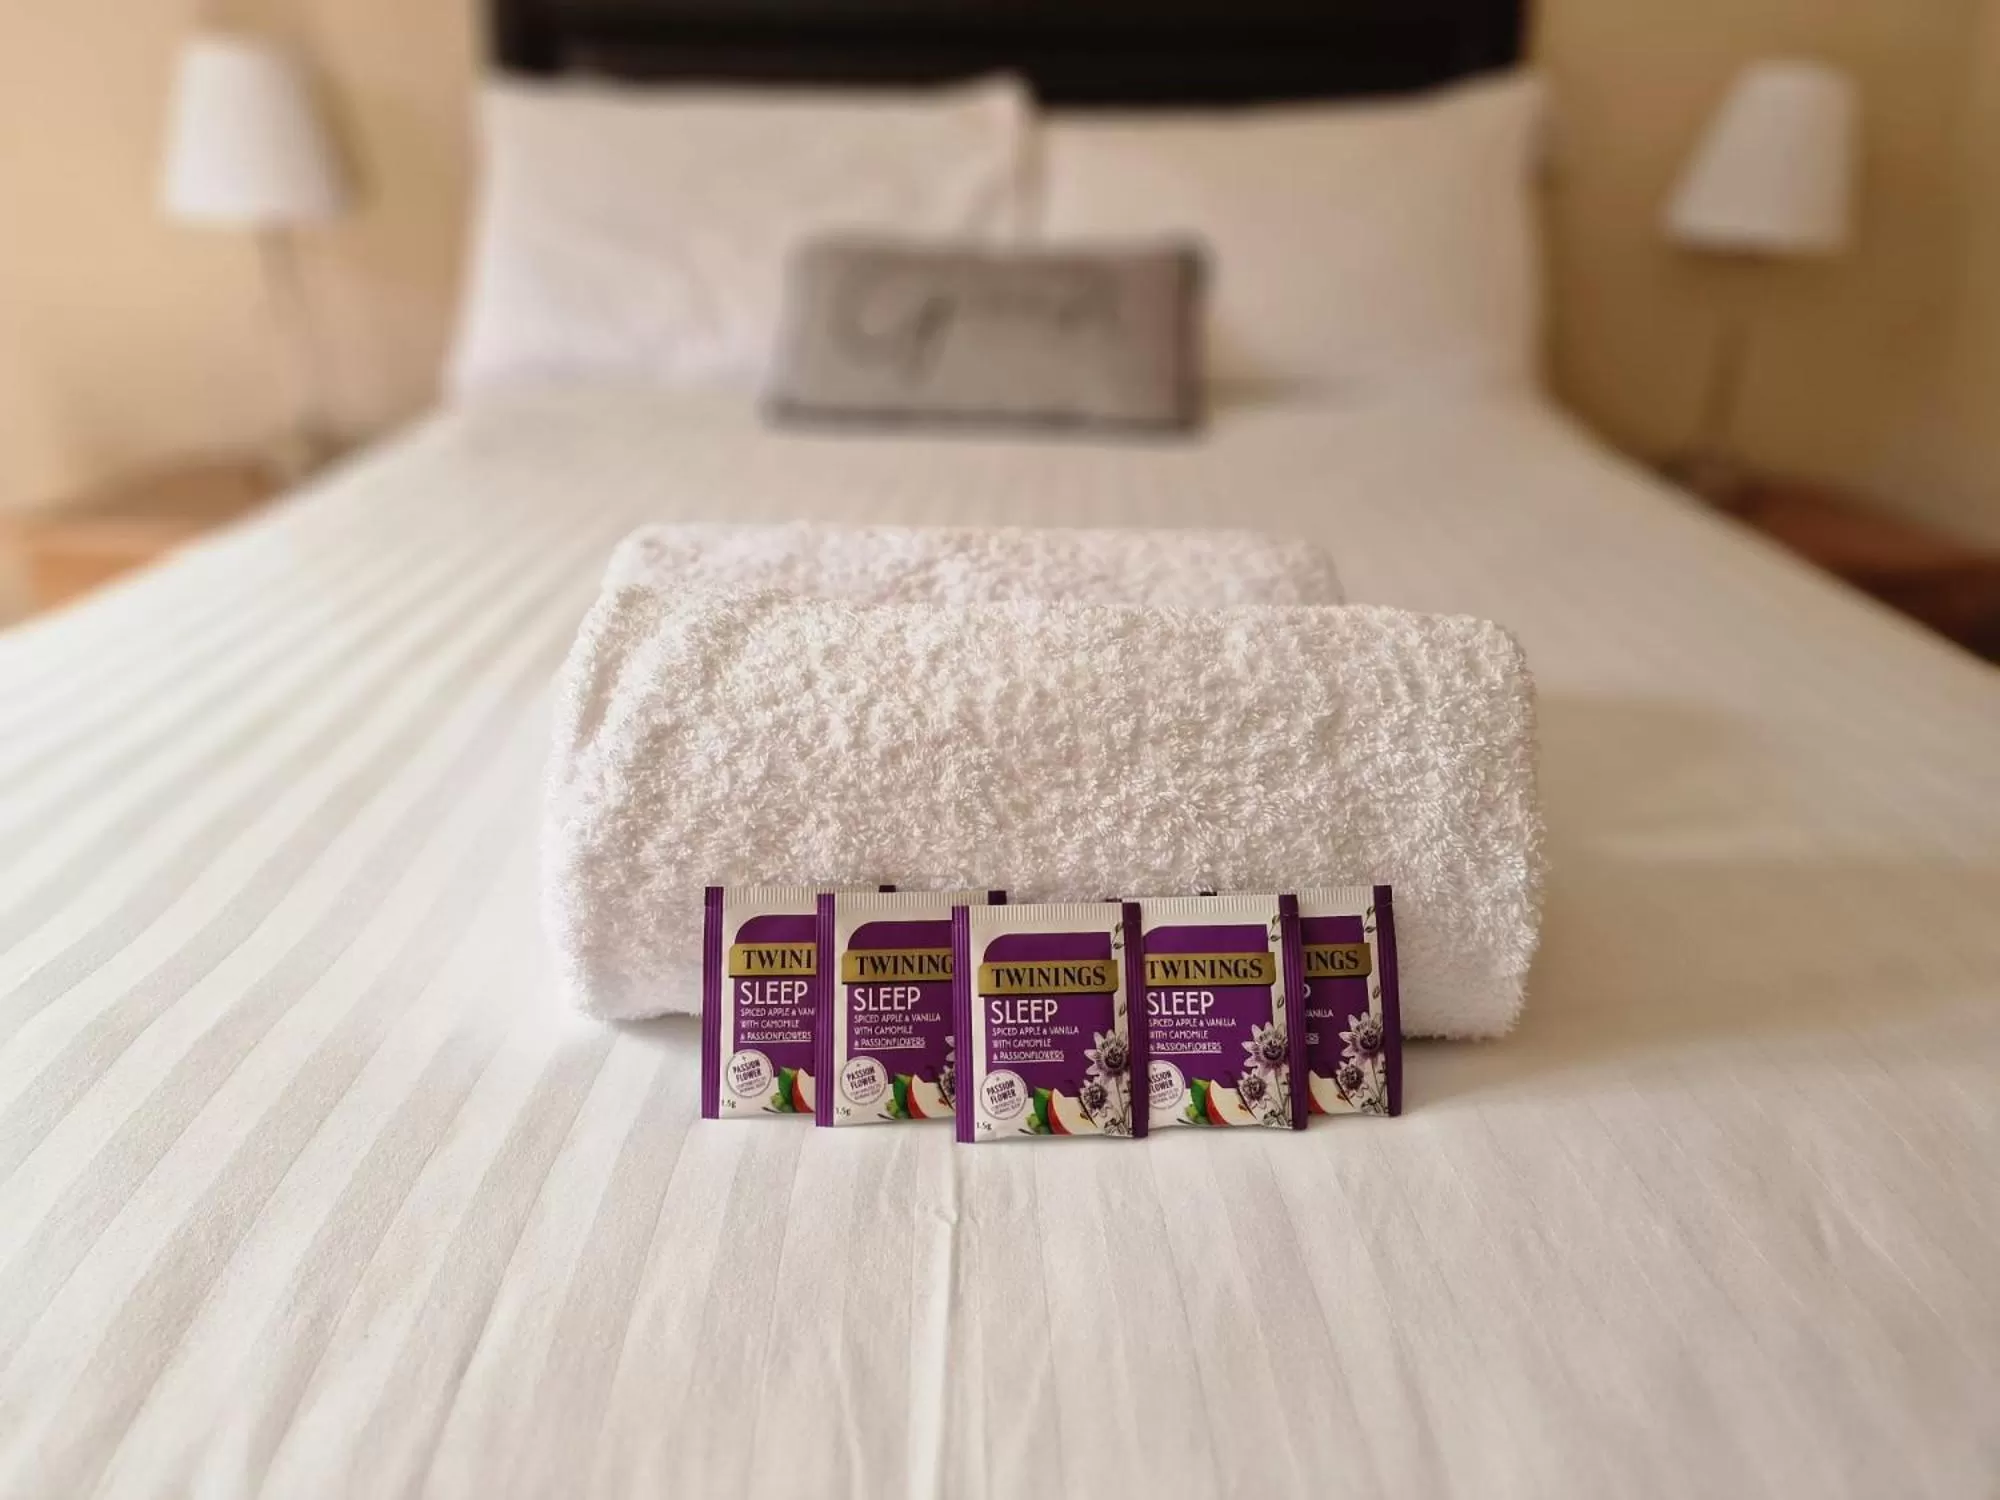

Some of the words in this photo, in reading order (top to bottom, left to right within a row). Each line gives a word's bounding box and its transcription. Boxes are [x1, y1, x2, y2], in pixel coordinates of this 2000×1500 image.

[742, 949, 812, 970] TWINI
[1146, 958, 1264, 980] TWININGS
[992, 966, 1106, 989] TWININGS
[740, 981, 808, 1005] SLEEP
[853, 986, 921, 1011] SLEEP
[1146, 991, 1215, 1016] SLEEP
[741, 1008, 765, 1017] SPICED
[768, 1008, 789, 1017] APPLE
[854, 1014, 879, 1023] SPICED
[881, 1014, 903, 1022] APPLE
[912, 1012, 941, 1021] VANILLA
[991, 999, 1059, 1025] SLEEP
[741, 1020, 759, 1029] WITH
[761, 1020, 800, 1029] CAMOMILE
[1149, 1018, 1174, 1028] SPICED
[1175, 1018, 1198, 1028] APPLE
[1206, 1017, 1237, 1027] VANILLA
[747, 1031, 812, 1041] PASSIONFLOWERS
[854, 1026, 873, 1035] WITH
[874, 1025, 913, 1034] CAMOMILE
[992, 1027, 1018, 1037] SPICED
[1019, 1027, 1041, 1036] APPLE
[1049, 1025, 1080, 1036] VANILLA
[1169, 1029, 1209, 1039] CAMOMILE
[860, 1037, 926, 1047] PASSIONFLOWERS
[992, 1039, 1011, 1048] WITH
[1013, 1038, 1052, 1048] CAMOMILE
[1156, 1041, 1222, 1052] PASSIONFLOWERS
[999, 1050, 1065, 1061] PASSIONFLOWERS
[732, 1059, 761, 1074] PASSION
[735, 1069, 762, 1082] FLOWER
[846, 1066, 876, 1081] PASSION
[849, 1076, 877, 1090] FLOWER
[986, 1079, 1016, 1096] PASSION
[989, 1089, 1017, 1105] FLOWER
